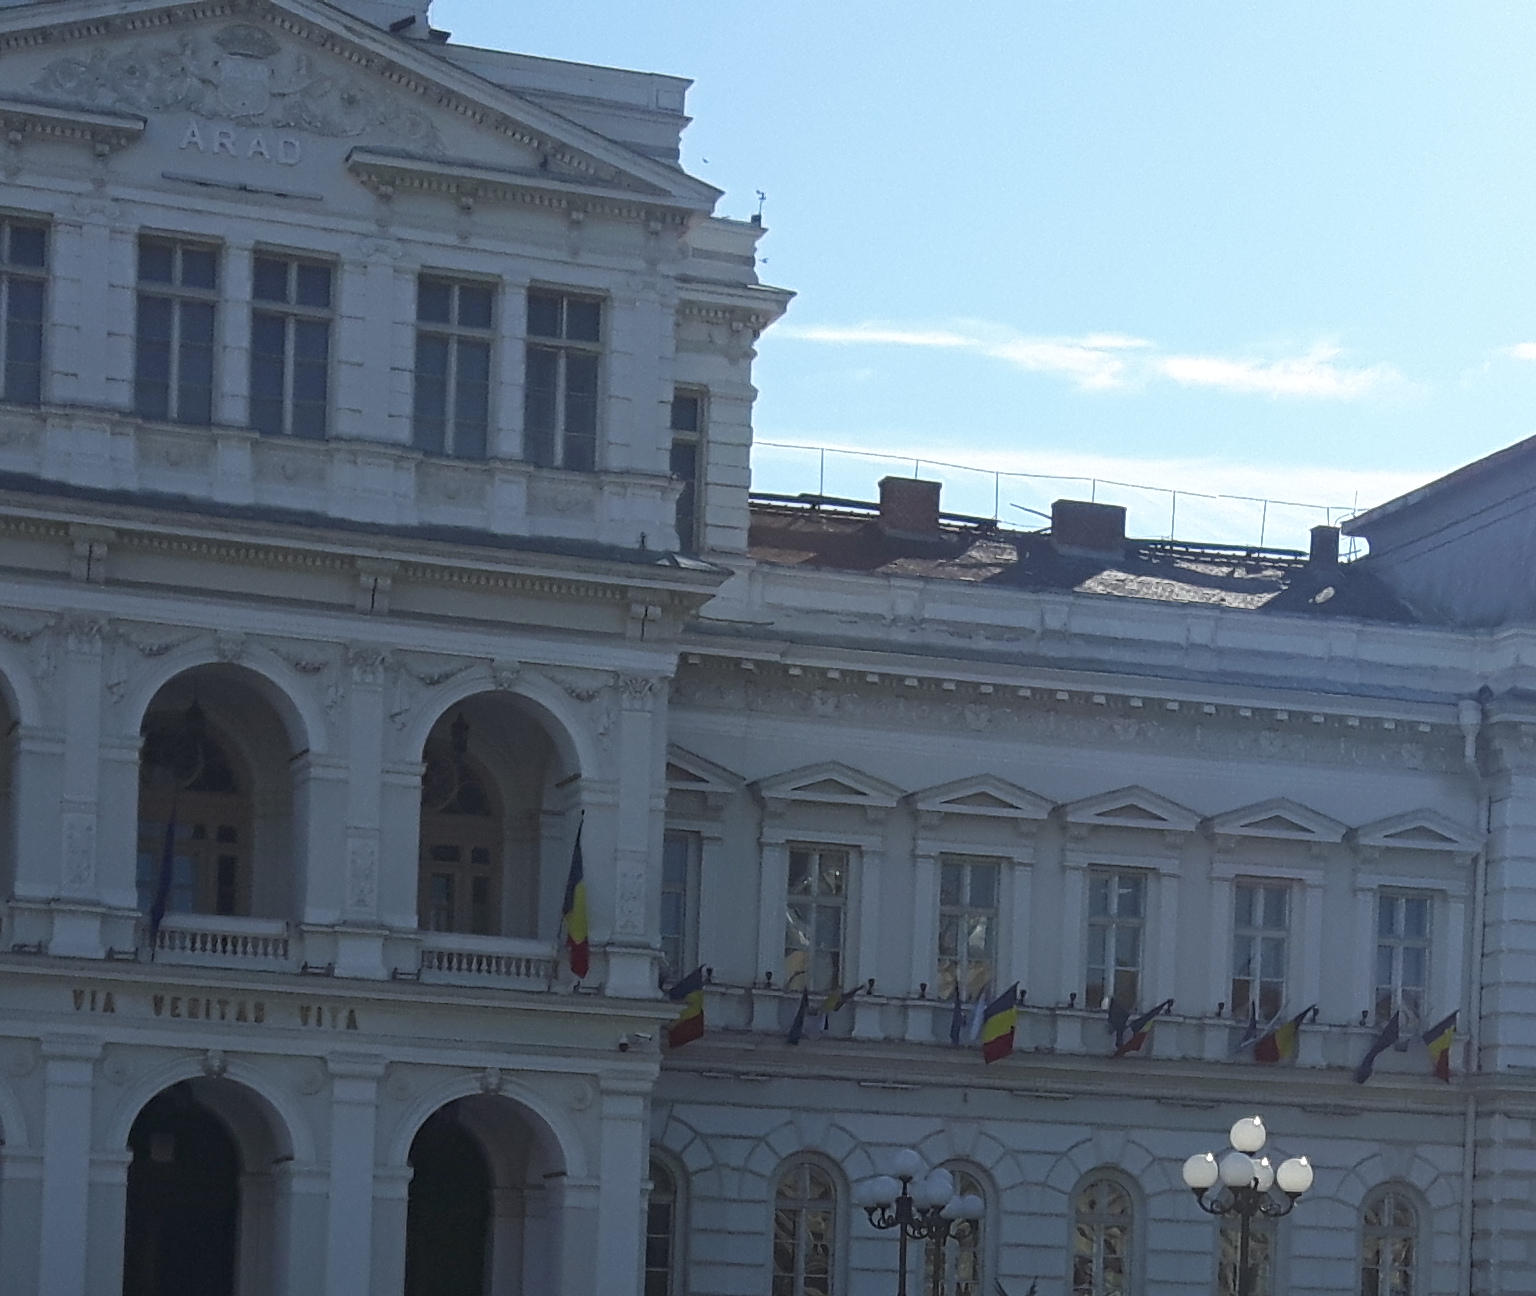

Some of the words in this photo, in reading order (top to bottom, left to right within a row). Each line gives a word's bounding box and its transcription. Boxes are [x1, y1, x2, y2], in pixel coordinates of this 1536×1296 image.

[179, 120, 302, 167] ARAD
[72, 988, 116, 1013] VIA
[152, 993, 266, 1024] VERITAS
[298, 1005, 358, 1030] VITA
